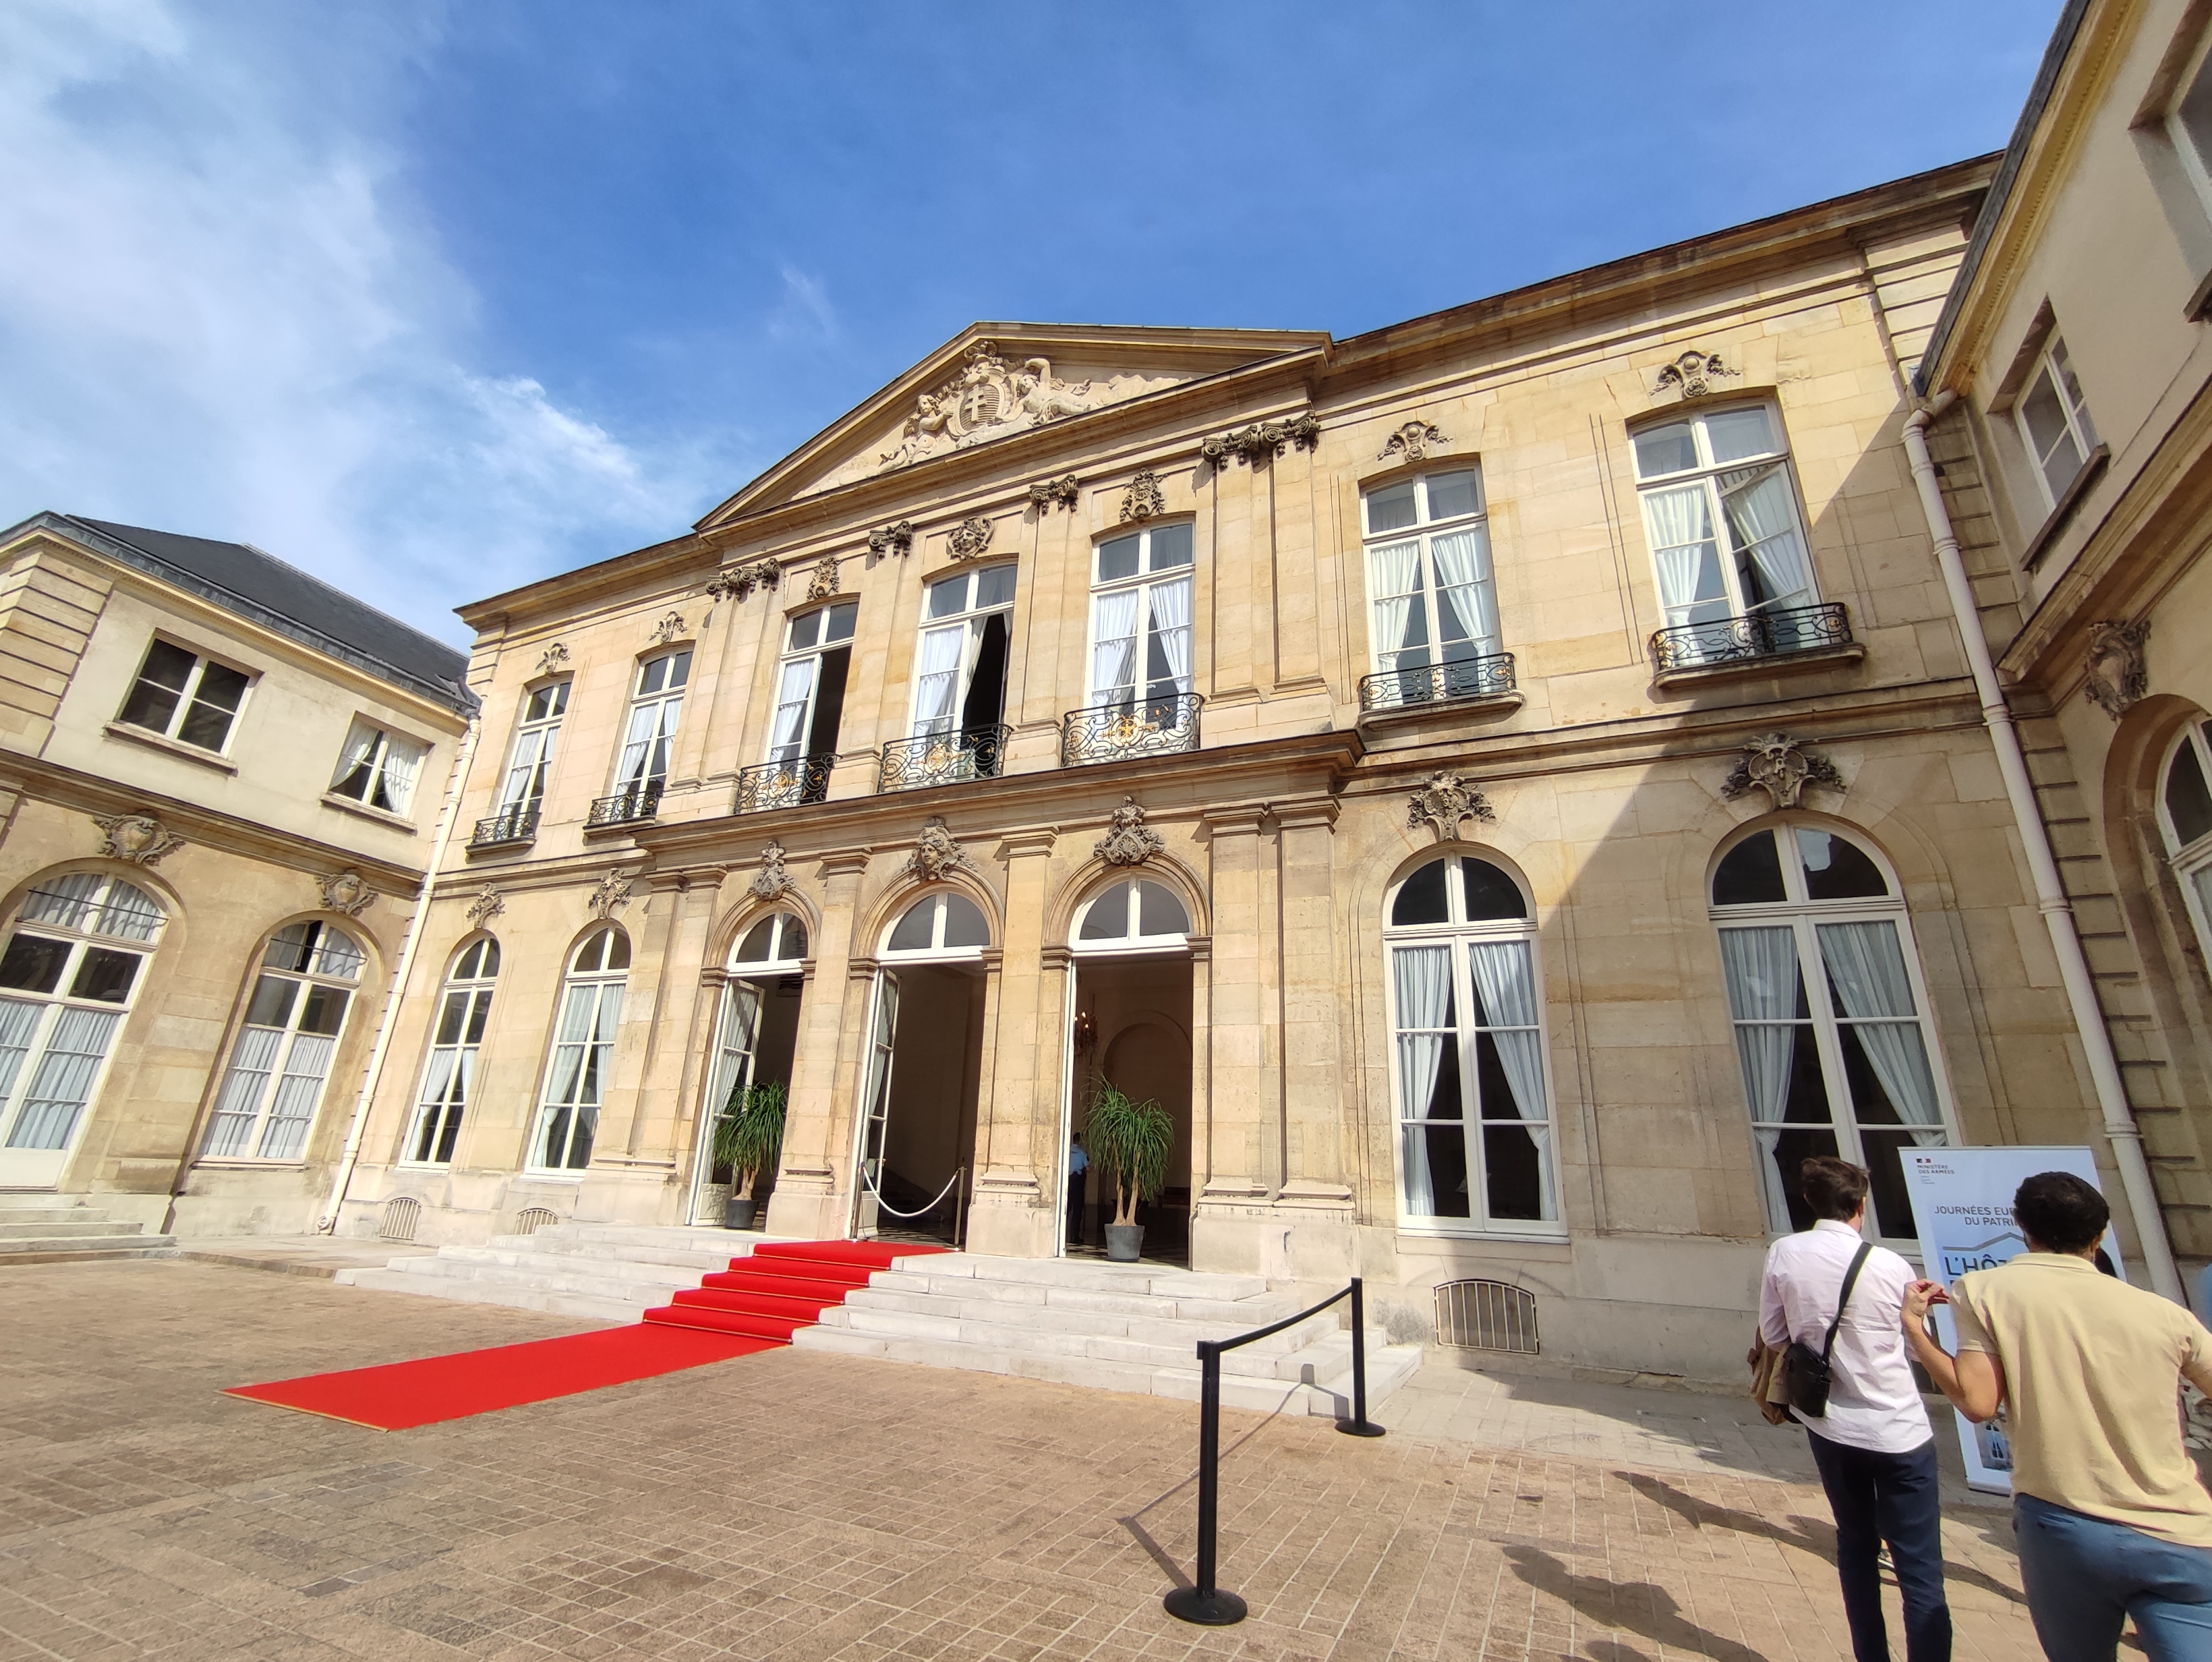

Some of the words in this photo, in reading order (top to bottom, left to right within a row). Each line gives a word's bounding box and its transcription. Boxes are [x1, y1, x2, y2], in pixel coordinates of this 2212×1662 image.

[1934, 1205, 1991, 1215] JOURNÉES
[1964, 1217, 1980, 1226] DU
[1983, 1217, 2017, 1227] PATRI
